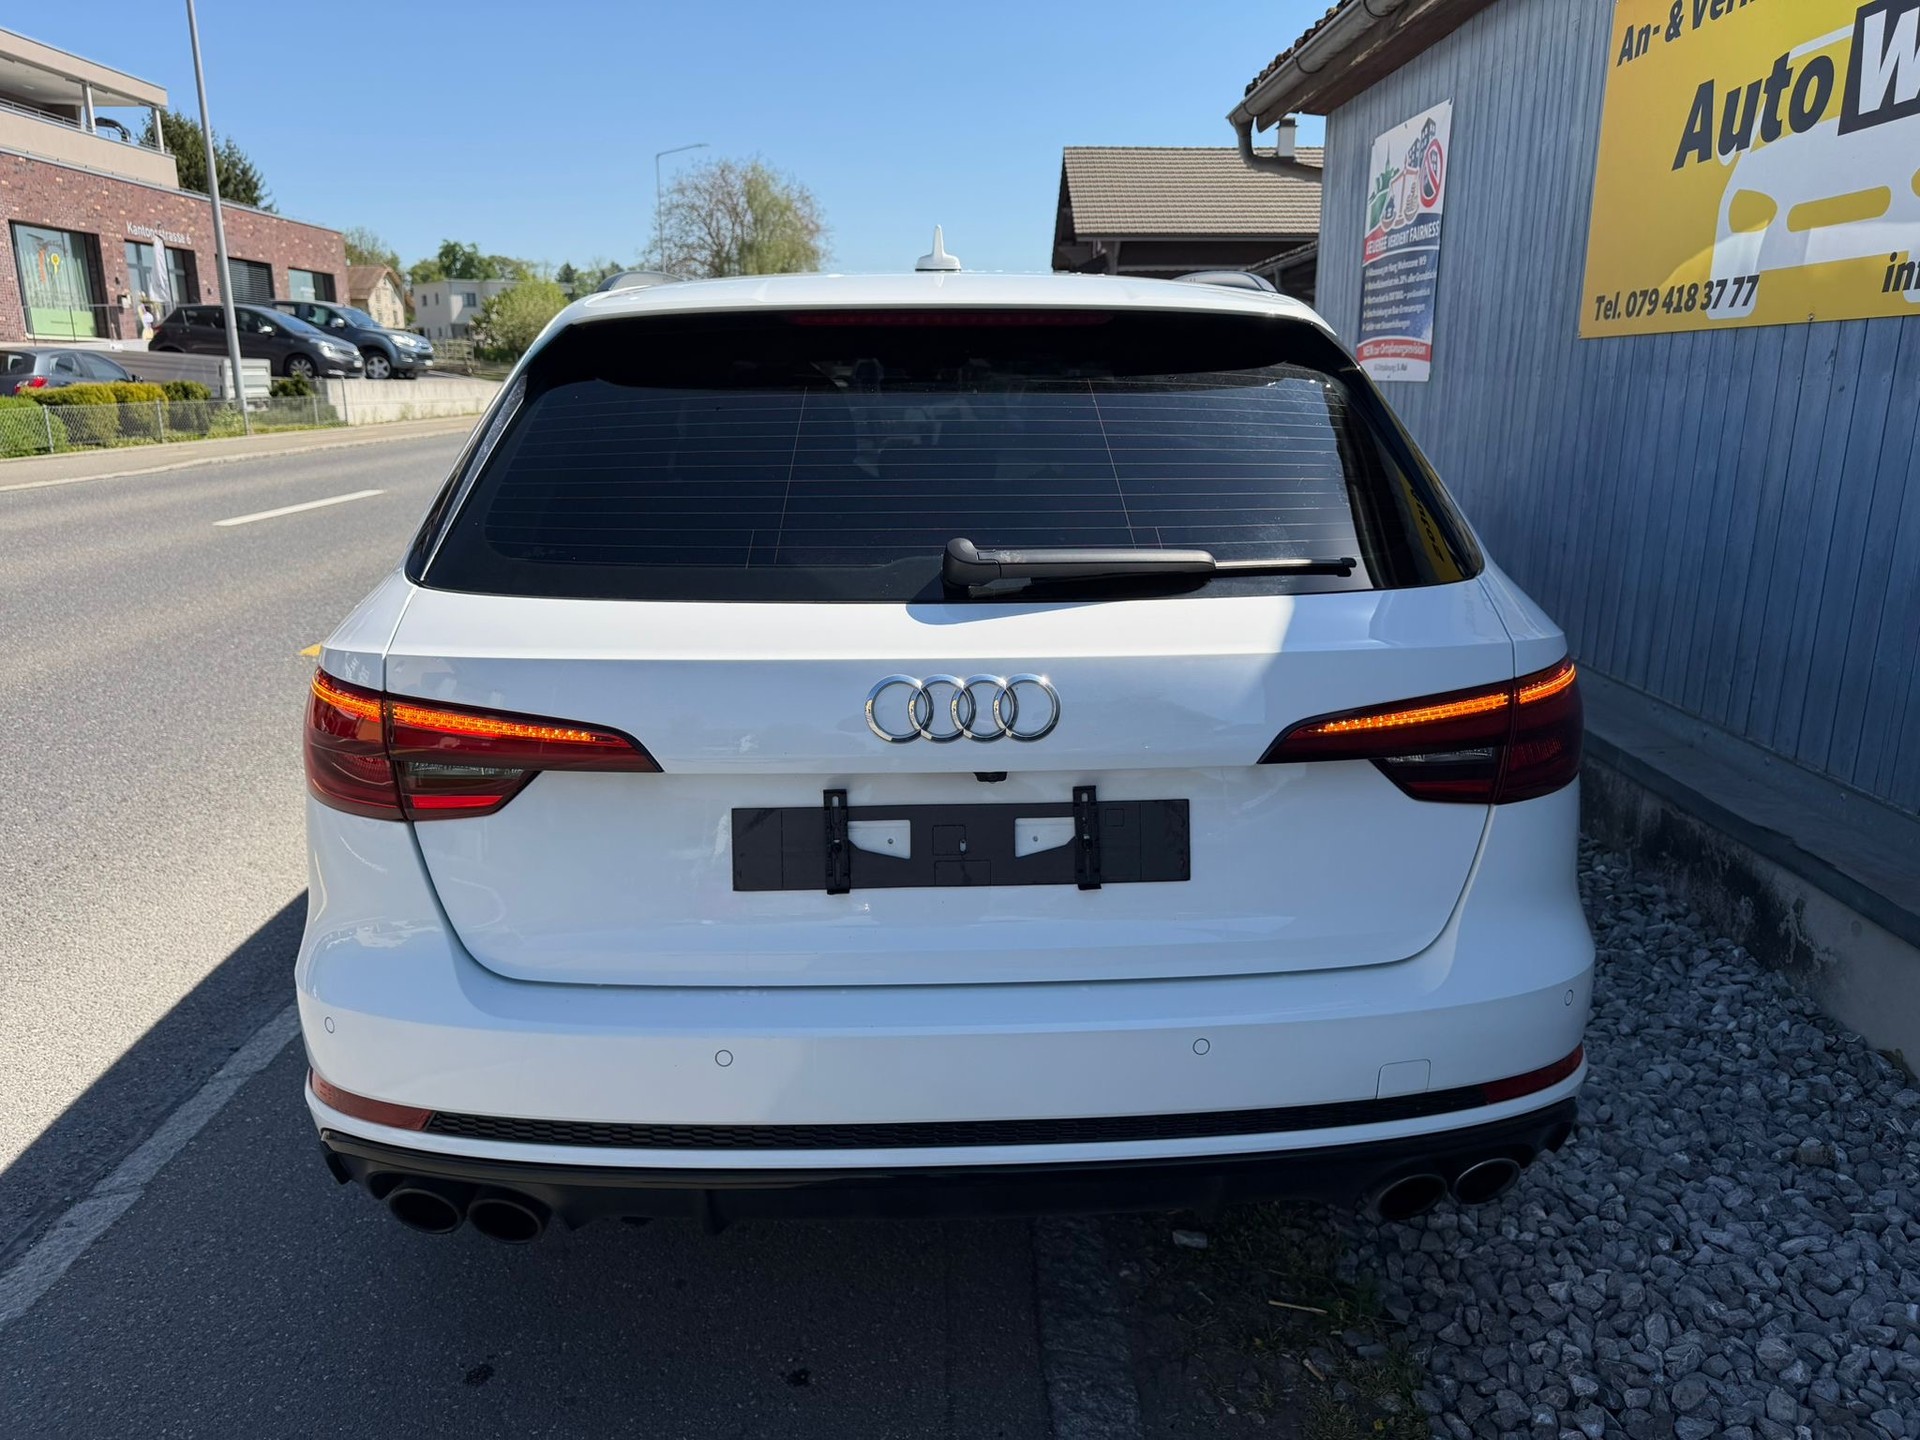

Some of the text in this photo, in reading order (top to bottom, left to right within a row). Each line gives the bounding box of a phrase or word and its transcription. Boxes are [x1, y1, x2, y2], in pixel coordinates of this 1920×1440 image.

[1616, 24, 1661, 67] An-
[1665, 0, 1684, 42] &
[1672, 51, 1835, 171] Auto
[1409, 220, 1440, 243] FAIRNESS
[1595, 275, 1760, 321] Tel. 079 418 37 77
